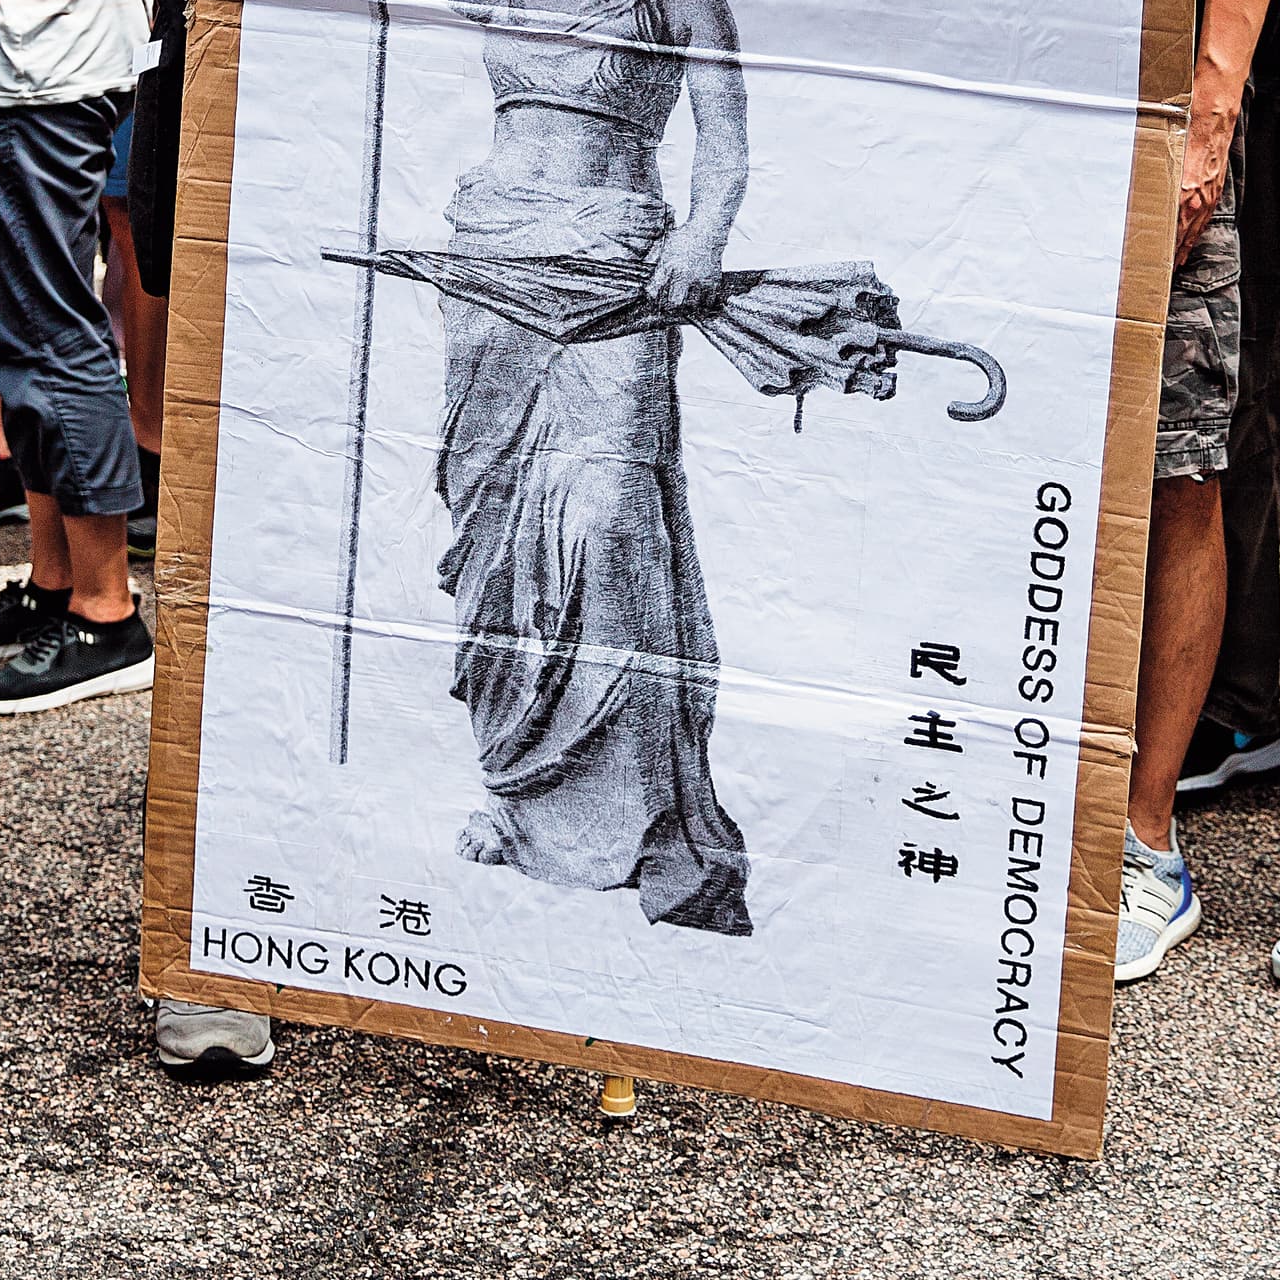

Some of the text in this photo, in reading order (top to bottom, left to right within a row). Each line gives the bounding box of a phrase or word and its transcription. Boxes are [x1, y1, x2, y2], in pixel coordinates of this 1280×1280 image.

[990, 481, 1073, 1079] GODDESS OF DEMOCRACY
[243, 874, 432, 937] 香港
[203, 927, 468, 997] HONG KONG
